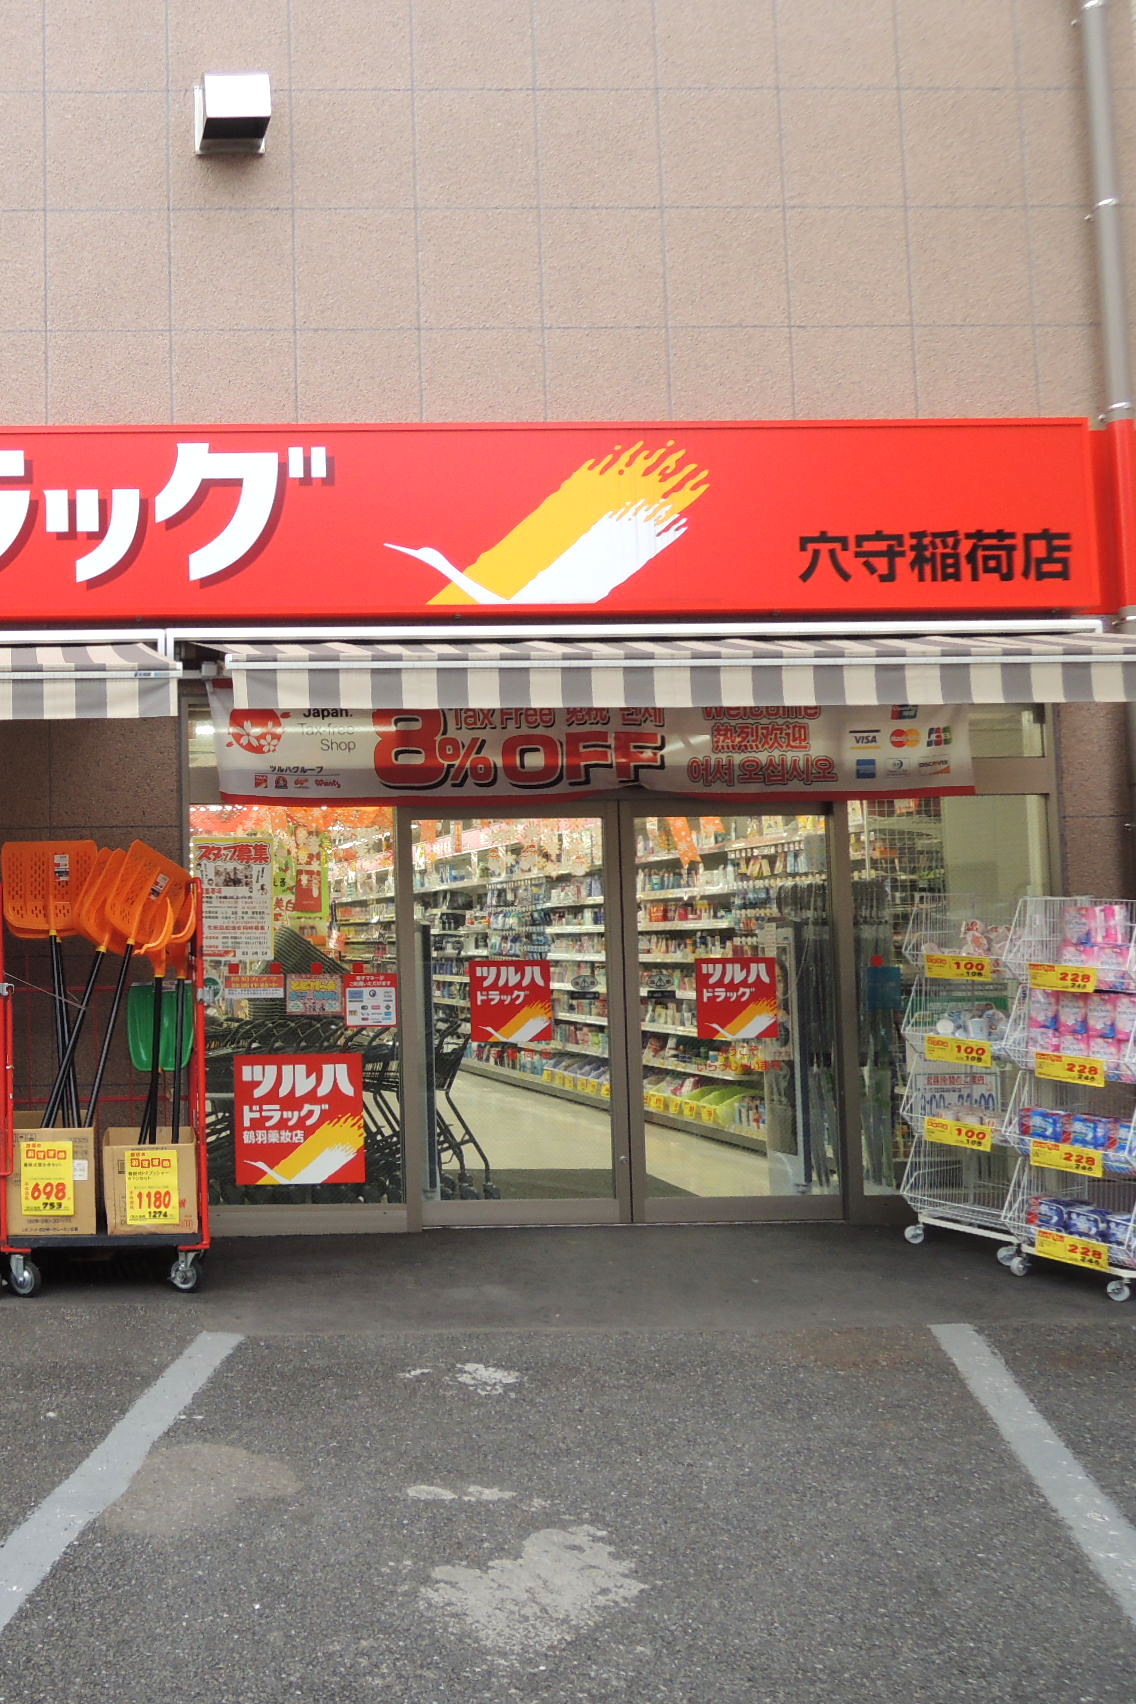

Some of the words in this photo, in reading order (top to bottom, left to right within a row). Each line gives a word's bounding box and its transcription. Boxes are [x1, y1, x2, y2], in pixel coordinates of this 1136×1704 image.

[798, 530, 1072, 584] 穴守稲荷店
[452, 707, 496, 729] Tax
[500, 707, 556, 729] Free
[320, 738, 357, 753] Shop
[711, 722, 812, 754] 热烈欢迎
[855, 735, 877, 744] VISA
[502, 731, 665, 789] OFF
[687, 755, 735, 787] 어서
[739, 754, 839, 786] 오십시오
[197, 842, 271, 864] スタッフ募集
[475, 965, 545, 988] ツルハ
[700, 962, 771, 984] ツルハ
[1060, 972, 1091, 983] 228
[476, 990, 529, 1006] ドラッグ
[703, 986, 756, 1002] ドラッグ
[956, 1044, 986, 1056] 100
[1066, 1062, 1099, 1076] 228
[242, 1063, 355, 1099] ツルハ
[243, 1103, 329, 1127] ドラッグ
[956, 1127, 986, 1140] 100
[1063, 1151, 1096, 1166] 228
[31, 1182, 67, 1201] 698
[137, 1190, 172, 1209] 1180
[148, 1210, 168, 1218] 1274
[1068, 1243, 1103, 1260] 228
